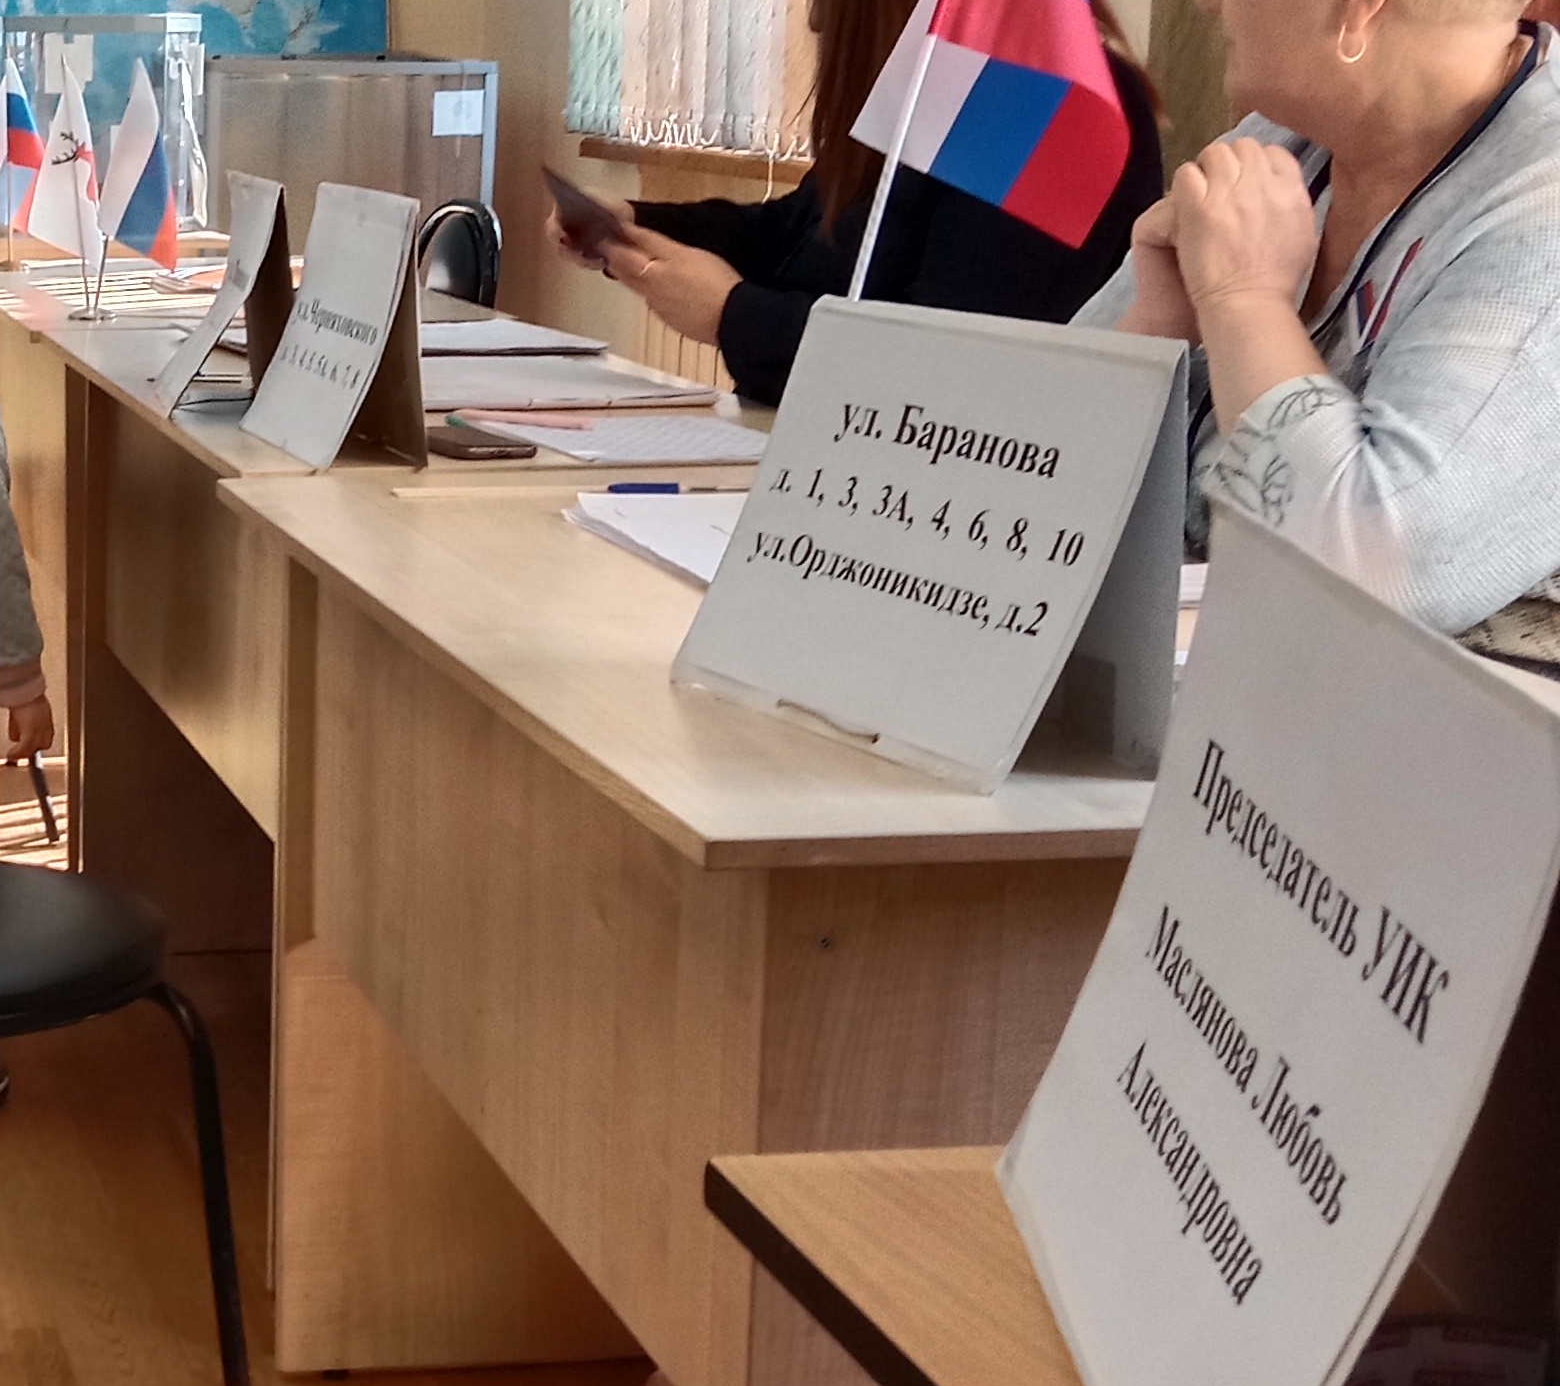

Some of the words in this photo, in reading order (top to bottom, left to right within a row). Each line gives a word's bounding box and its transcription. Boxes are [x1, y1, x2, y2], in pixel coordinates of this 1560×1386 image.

[769, 468, 792, 493] д.
[806, 467, 825, 508] 1,
[838, 475, 859, 517] 3,
[872, 484, 914, 532] 3А,
[931, 498, 952, 541] 4,
[968, 508, 991, 551] 6,
[1006, 517, 1030, 562] 8,
[1047, 527, 1085, 567] 10
[833, 403, 882, 443] ул.
[892, 403, 1061, 479] Баранова
[995, 600, 1049, 638] д.2
[1192, 738, 1360, 959] Председатель
[1361, 905, 1451, 1047] УИК
[1144, 903, 1260, 1095] Маслянова
[1250, 1054, 1348, 1227] Любовь
[1115, 1038, 1264, 1307] Александровна
